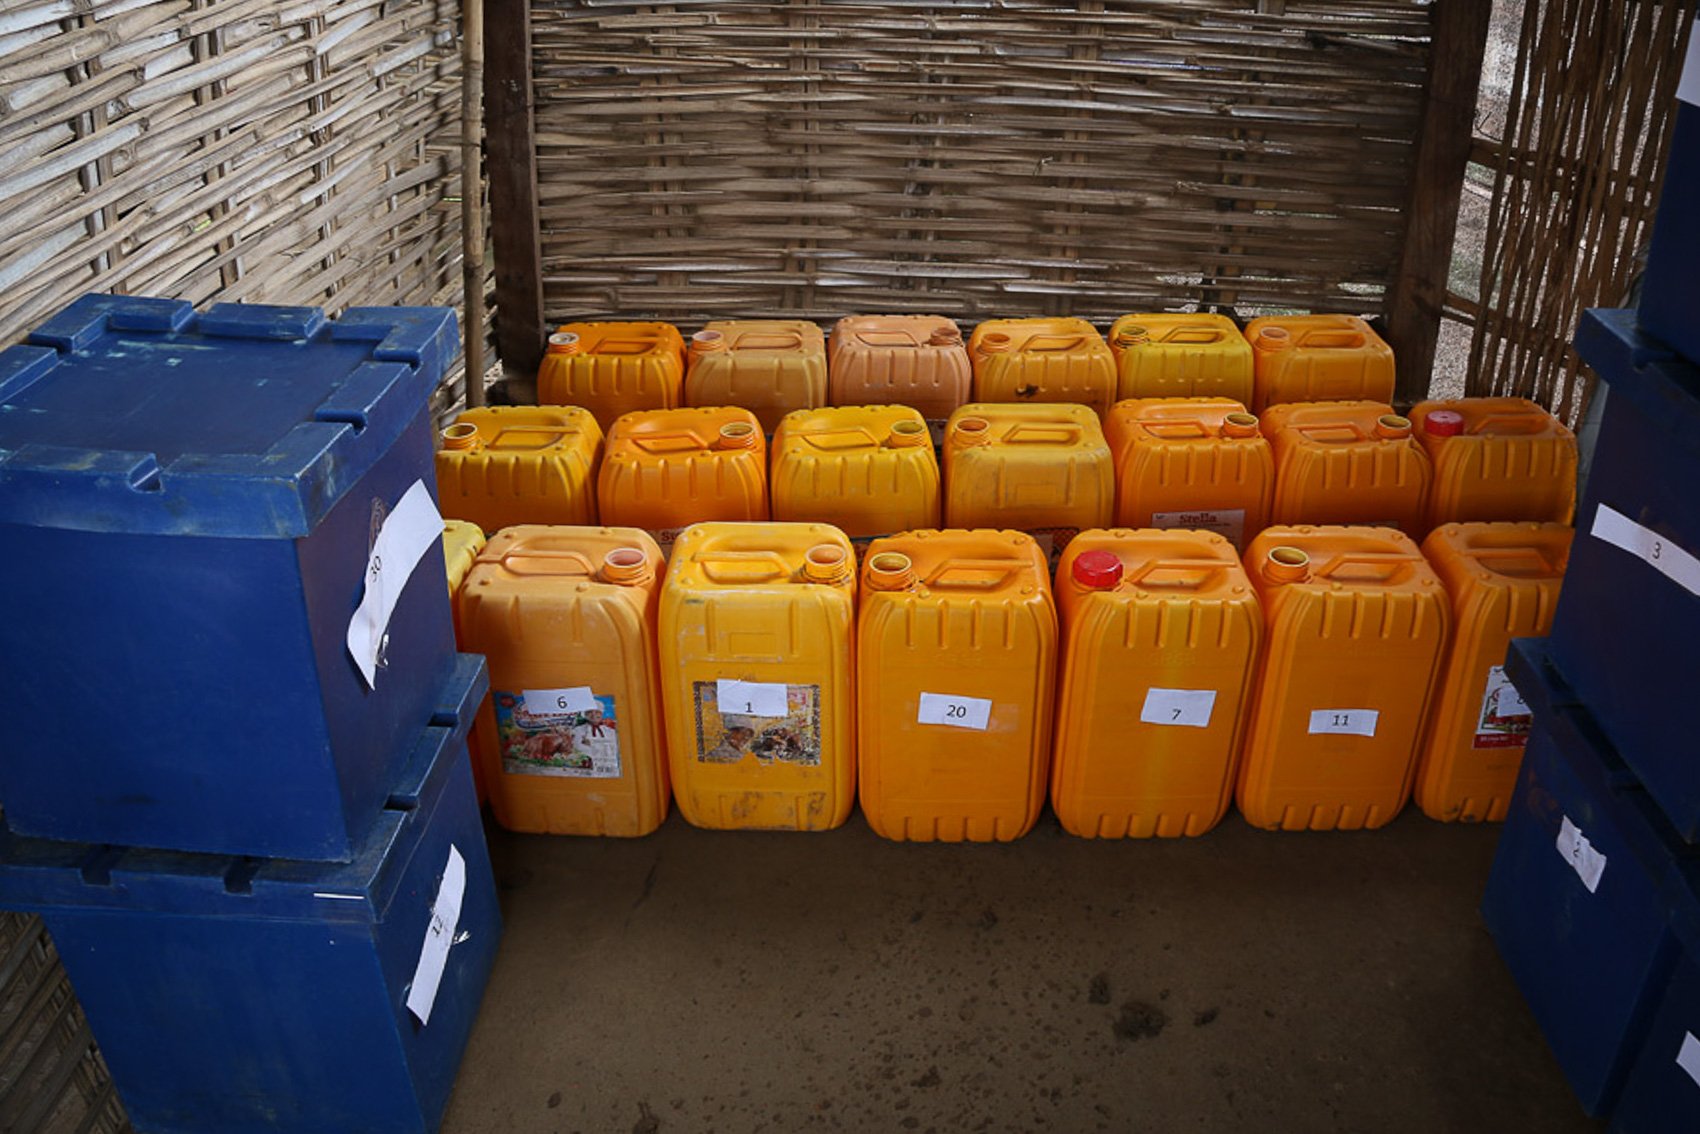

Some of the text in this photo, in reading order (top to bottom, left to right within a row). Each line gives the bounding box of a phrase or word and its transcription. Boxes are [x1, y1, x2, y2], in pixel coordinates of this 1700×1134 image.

[1652, 541, 1662, 560] 3
[557, 696, 568, 709] 6
[745, 702, 753, 713] 1
[946, 704, 967, 718] 20
[1172, 708, 1182, 720] 7
[1332, 714, 1349, 726] 11
